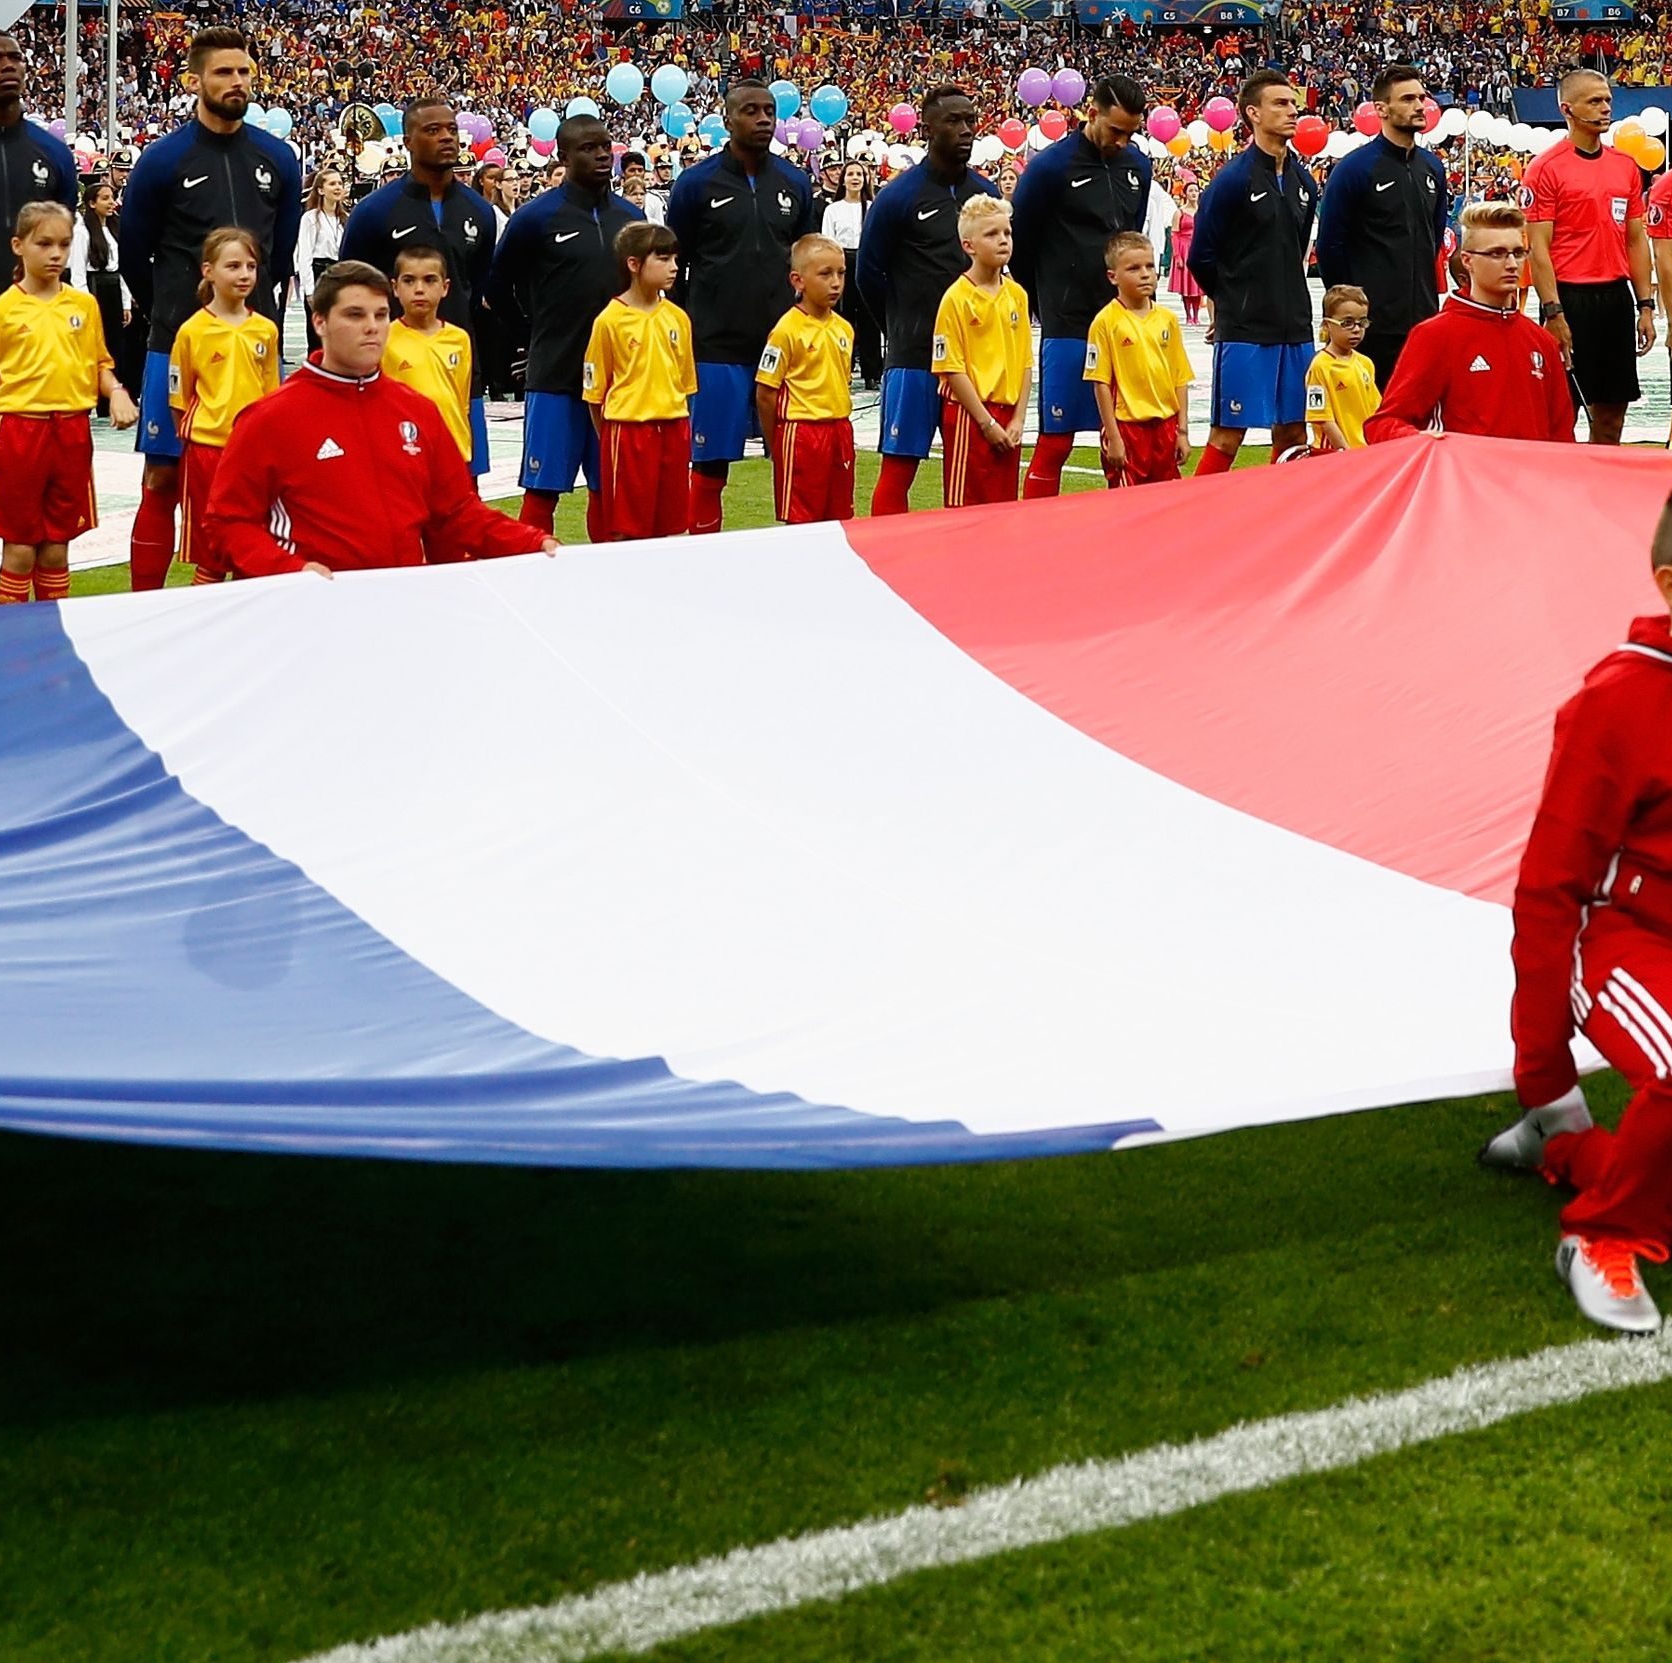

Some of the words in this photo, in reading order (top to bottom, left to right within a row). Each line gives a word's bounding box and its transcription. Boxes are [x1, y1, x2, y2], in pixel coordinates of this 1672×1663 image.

[629, 5, 641, 15] C6
[1557, 8, 1570, 16] B7
[1608, 8, 1621, 16] B6
[1163, 11, 1176, 20] C5
